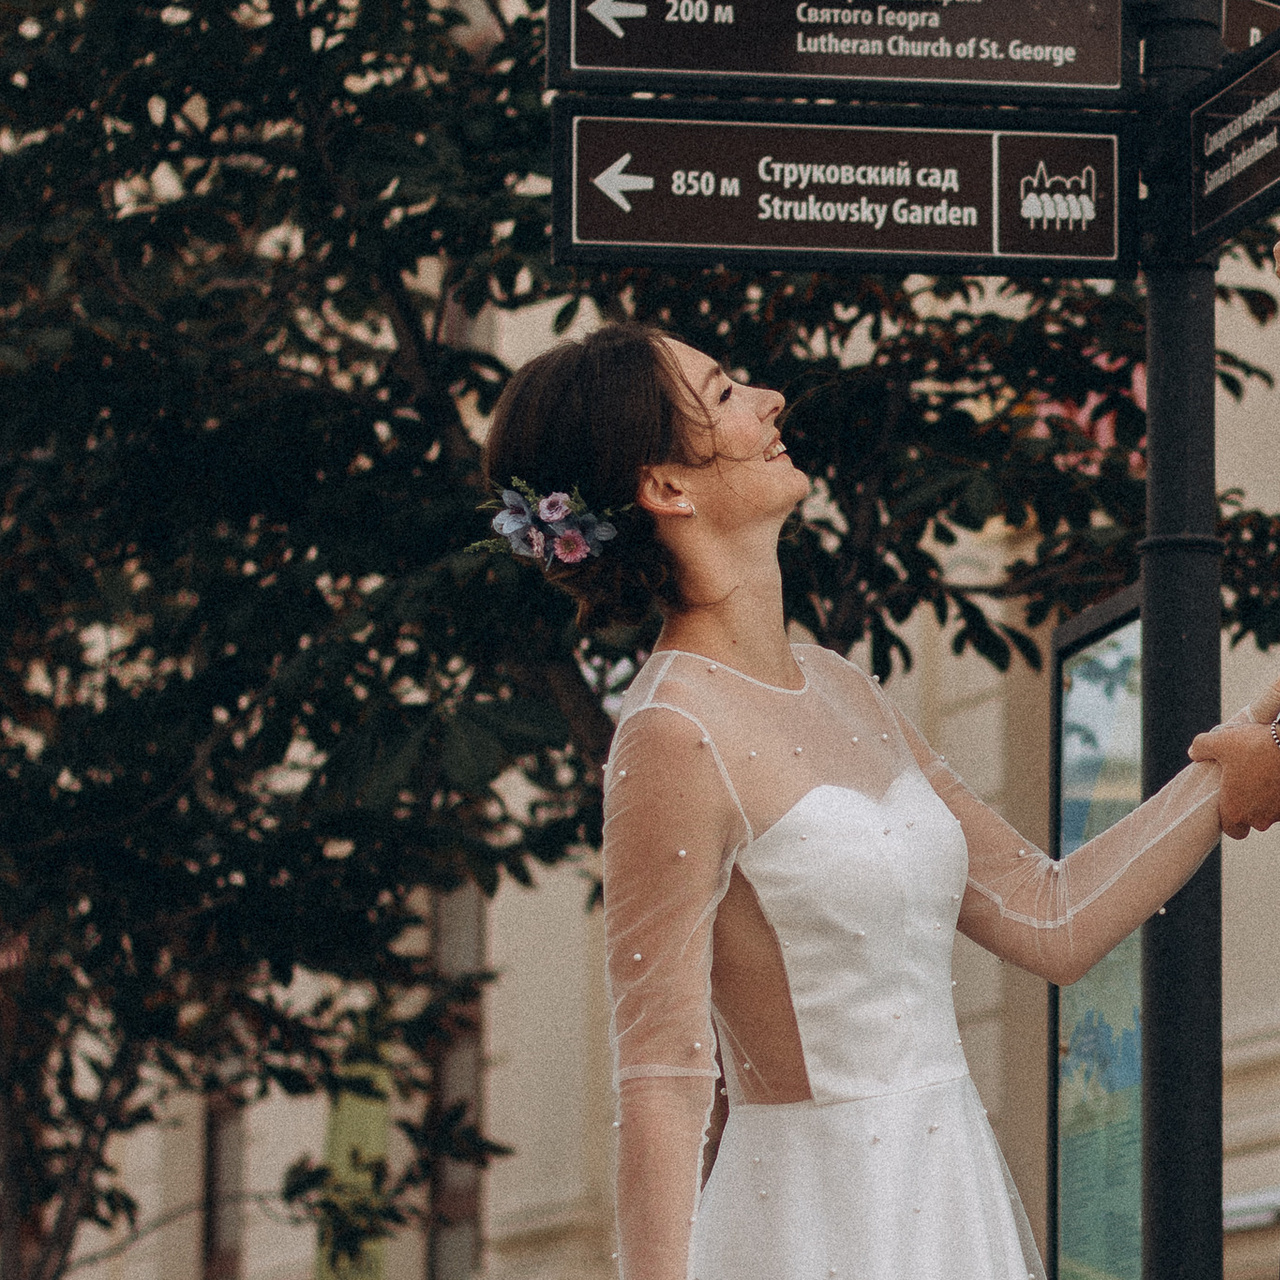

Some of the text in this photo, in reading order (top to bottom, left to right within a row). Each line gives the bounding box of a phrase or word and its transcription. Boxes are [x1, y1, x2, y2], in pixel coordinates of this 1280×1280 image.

[714, 4, 734, 24] м
[796, 2, 940, 32] Святого Георга
[796, 32, 1077, 68] Lutheran Church of St. George
[671, 170, 741, 198] 850 м
[757, 156, 960, 193] Струковский сад
[757, 193, 978, 231] Strukovsky Garden
